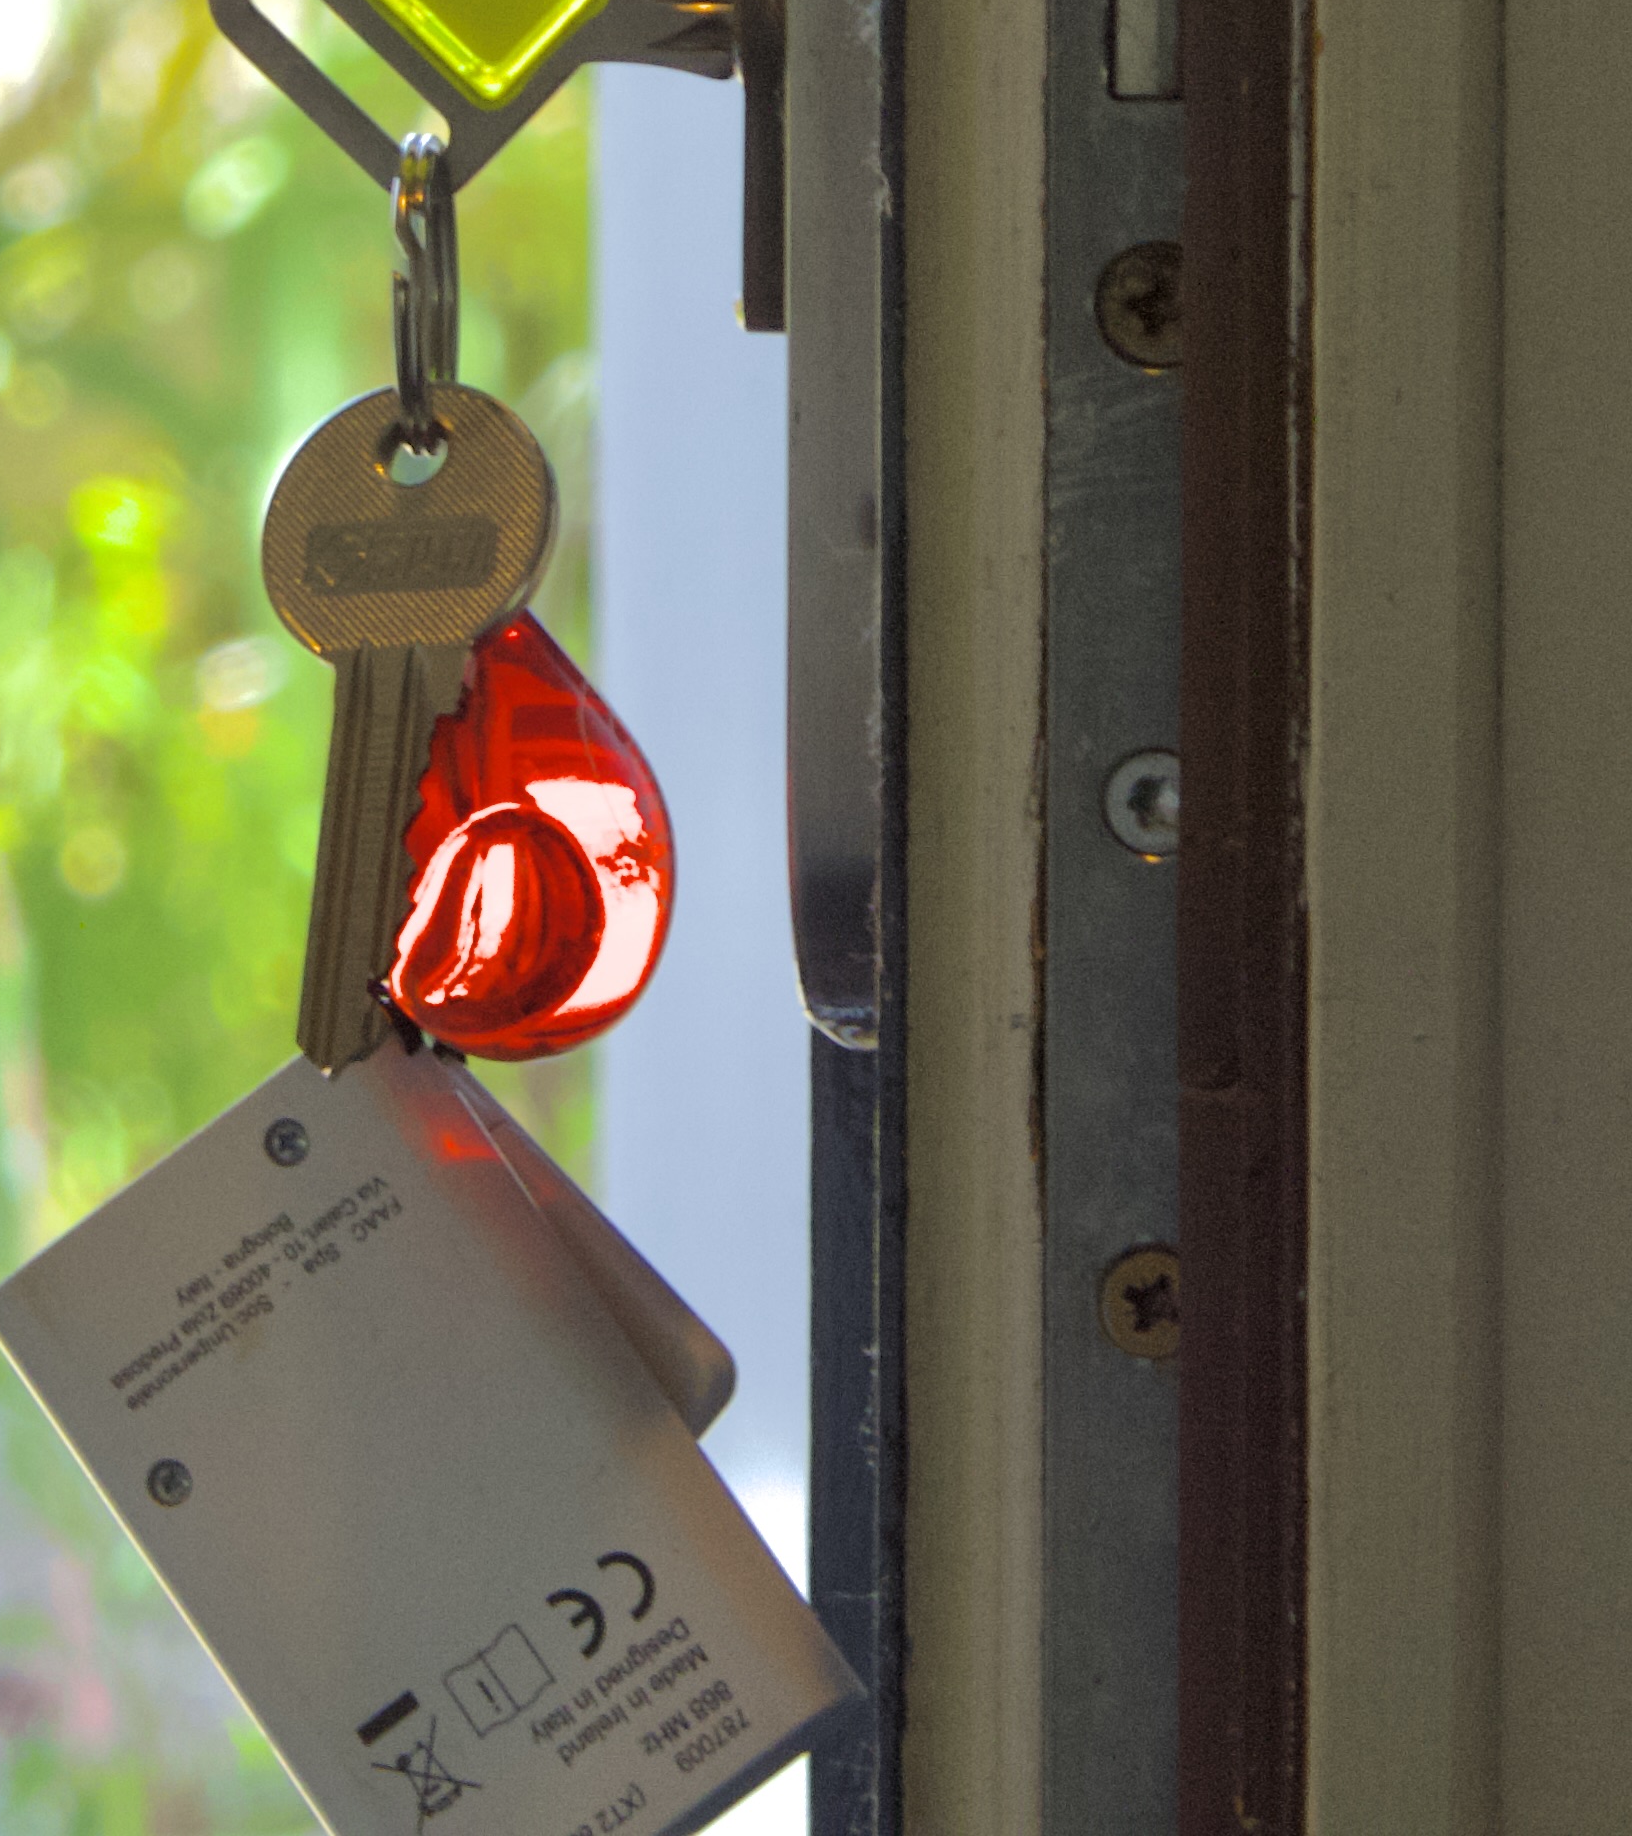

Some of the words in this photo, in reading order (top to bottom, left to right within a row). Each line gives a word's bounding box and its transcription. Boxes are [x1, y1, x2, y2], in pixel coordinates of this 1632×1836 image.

[357, 1176, 388, 1200] Via
[222, 1212, 294, 1269] Bologna
[352, 1195, 402, 1242] FAAC
[283, 1239, 306, 1262] 10
[175, 1274, 213, 1307] Italy
[180, 1301, 216, 1335] Zola
[111, 1332, 181, 1390] Predosa
[594, 1616, 692, 1699] Designed
[649, 1643, 709, 1692] Made
[573, 1687, 600, 1712] in
[625, 1686, 653, 1709] in
[530, 1702, 578, 1745] Italy
[557, 1704, 630, 1768] Ireland
[640, 1710, 691, 1756] MHz
[674, 1708, 751, 1773] 787009
[595, 1781, 647, 1833] (XT2
